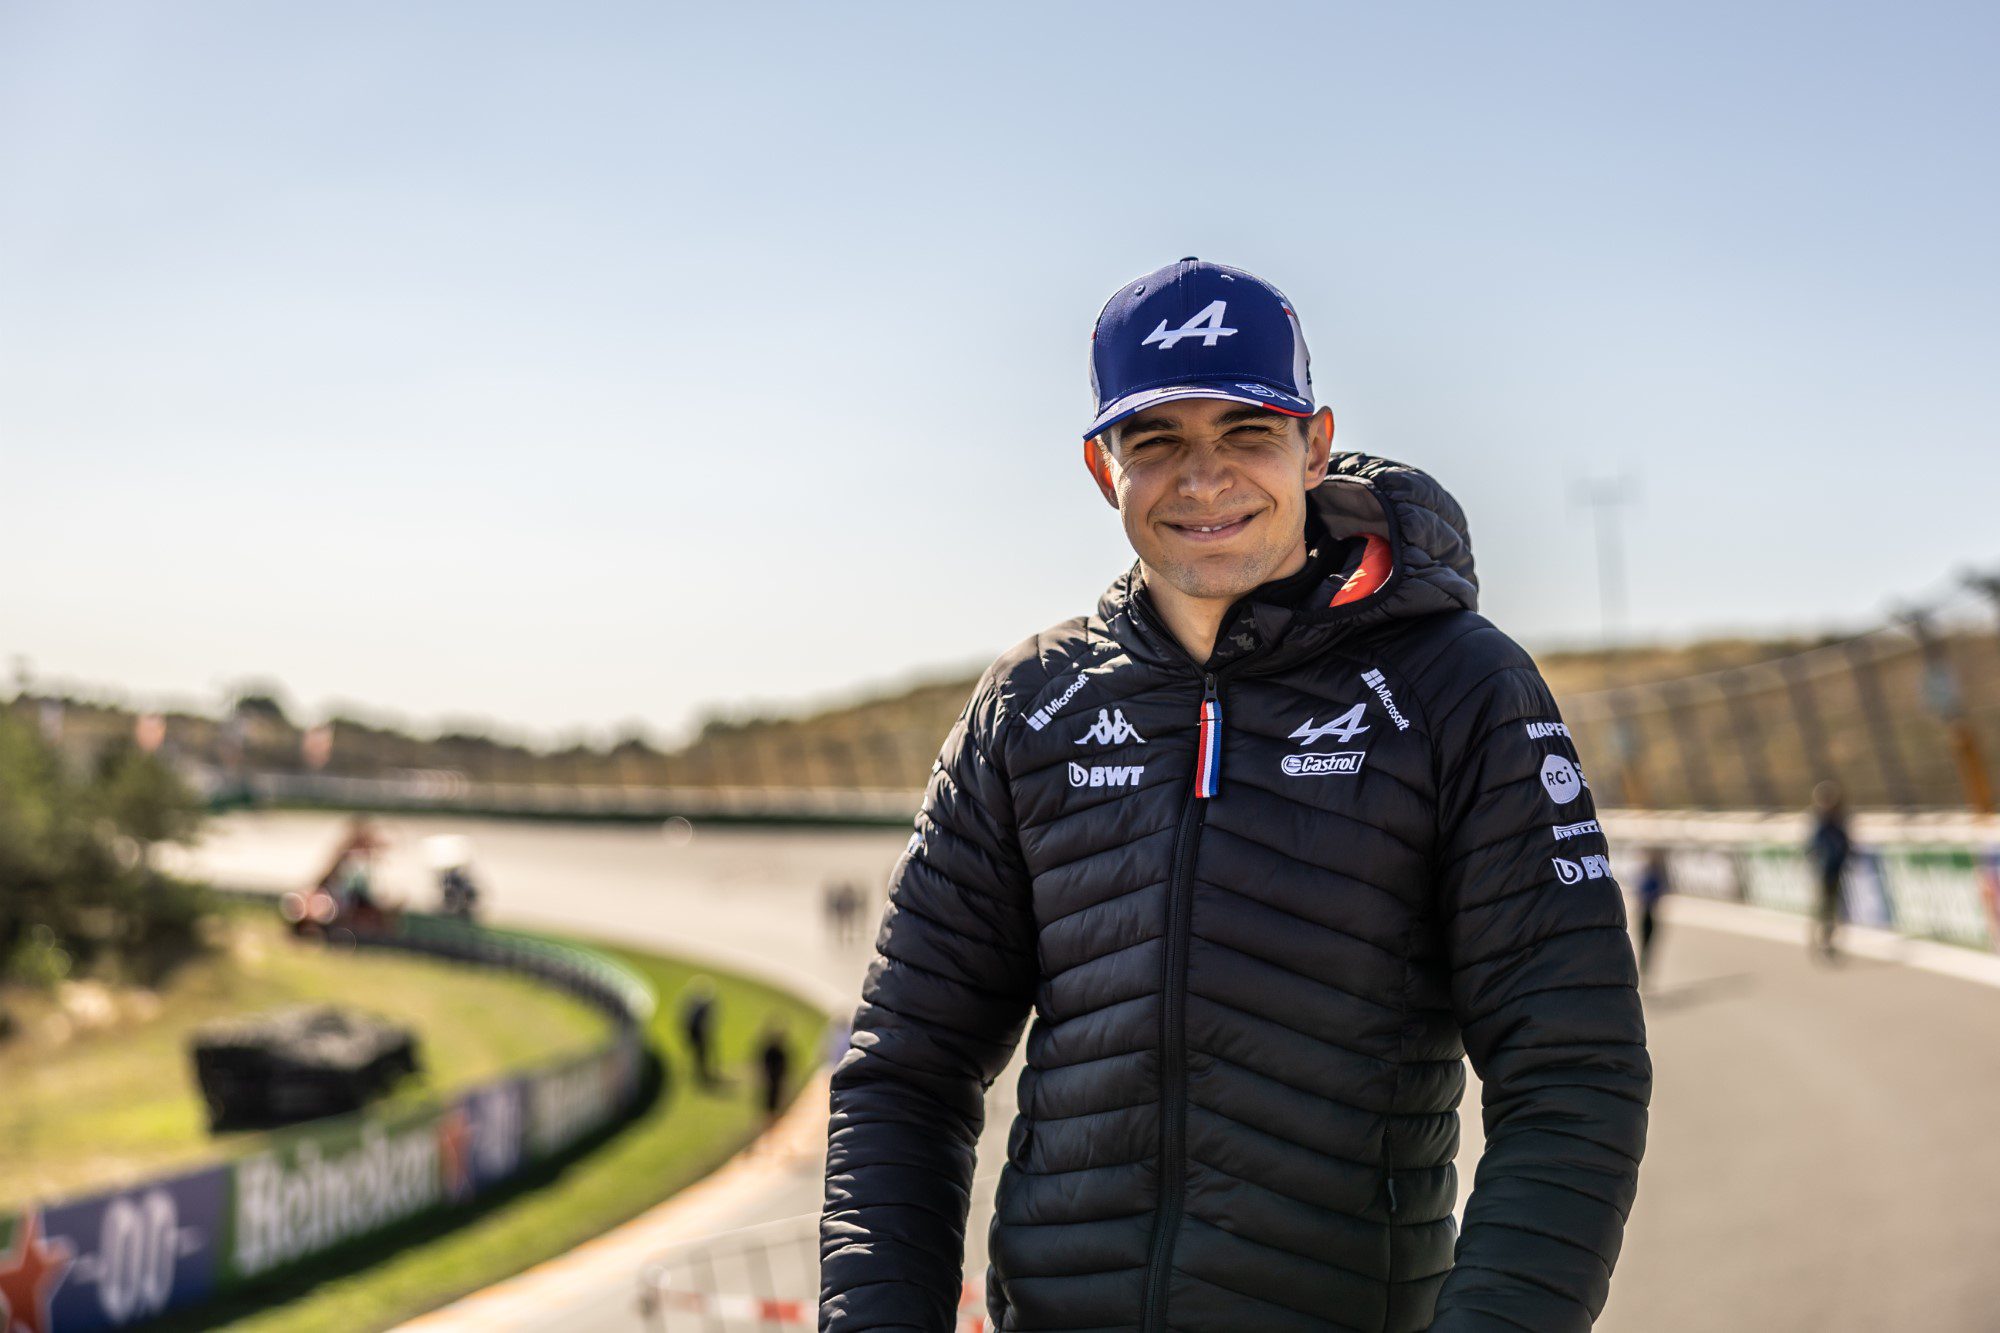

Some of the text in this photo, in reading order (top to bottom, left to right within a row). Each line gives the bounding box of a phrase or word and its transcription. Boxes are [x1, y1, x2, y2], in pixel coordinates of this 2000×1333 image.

[1044, 673, 1089, 716] Microsoft
[1374, 683, 1410, 731] Microsoft
[1089, 766, 1145, 787] BWT
[1301, 755, 1358, 772] Castrol
